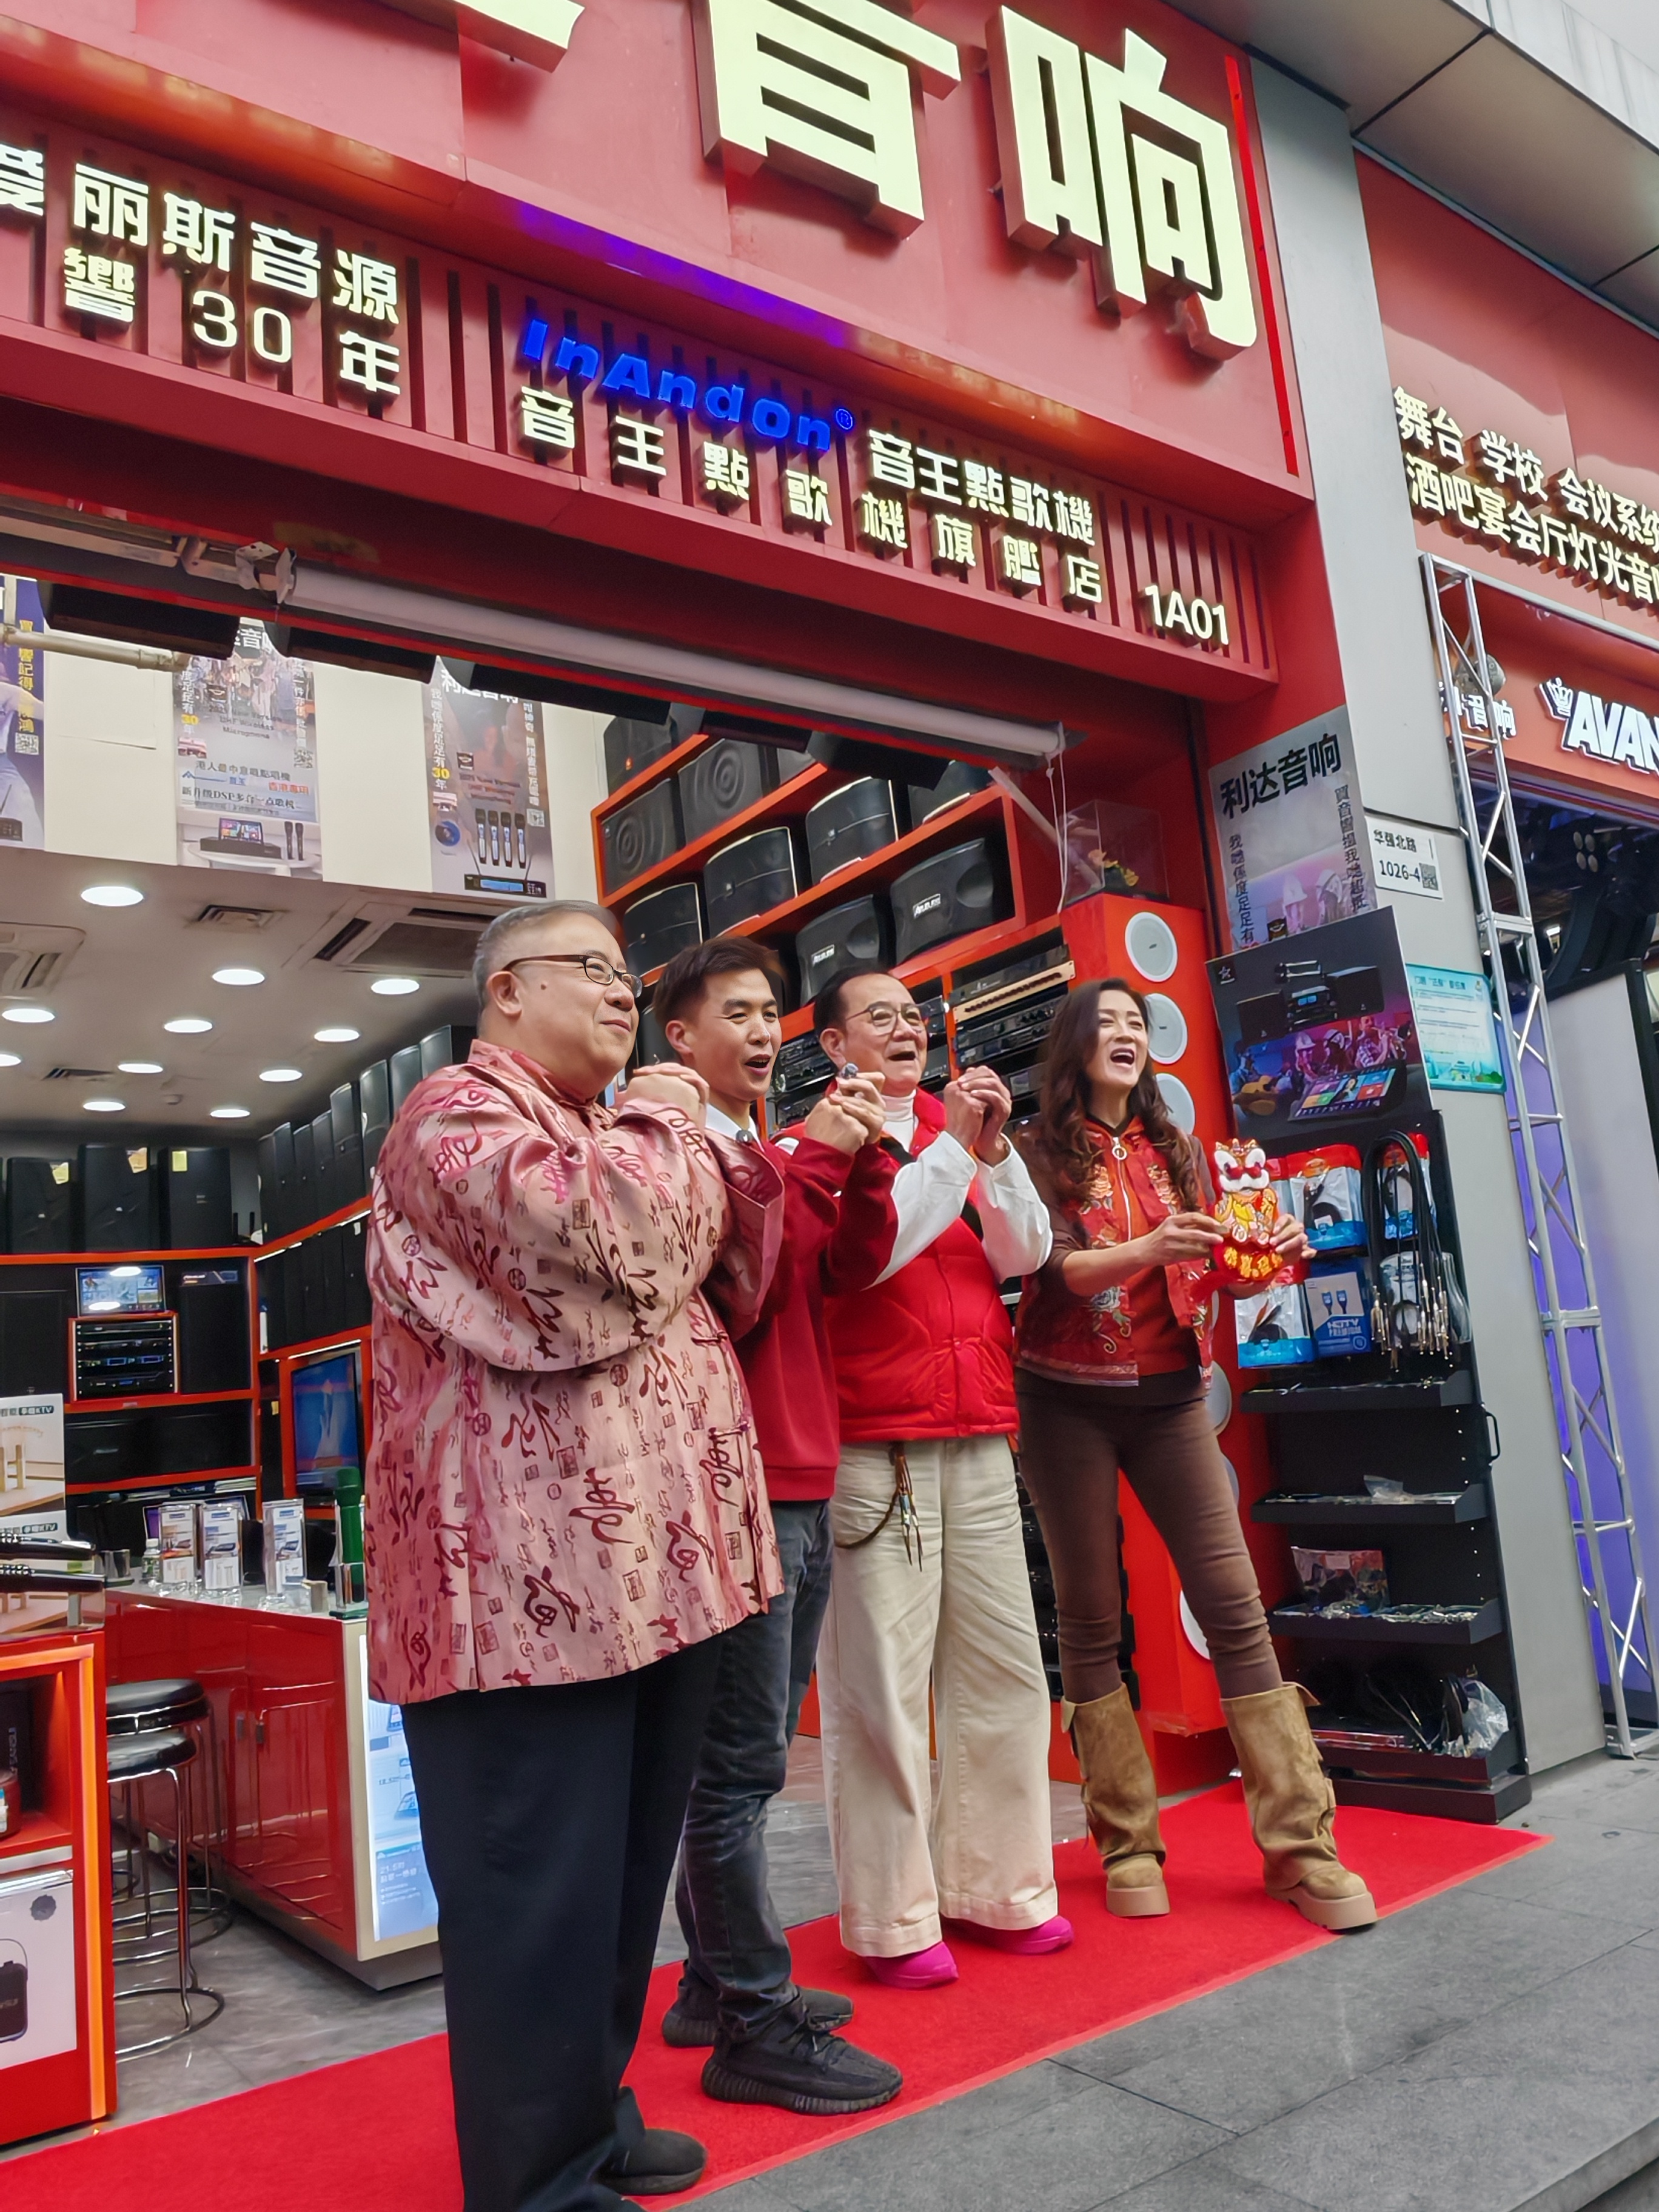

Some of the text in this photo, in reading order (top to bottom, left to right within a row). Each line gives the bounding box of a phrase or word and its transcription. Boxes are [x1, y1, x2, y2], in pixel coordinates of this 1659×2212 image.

[869, 429, 1095, 546] 音王點歌機
[1394, 388, 1465, 464] 舞台
[1480, 429, 1548, 501] 学校
[1405, 452, 1659, 604] 酒吧宴会厅灯光音
[1144, 584, 1230, 646] 1A01
[1220, 732, 1342, 820] 利达音响
[1379, 860, 1421, 883] 1026-4
